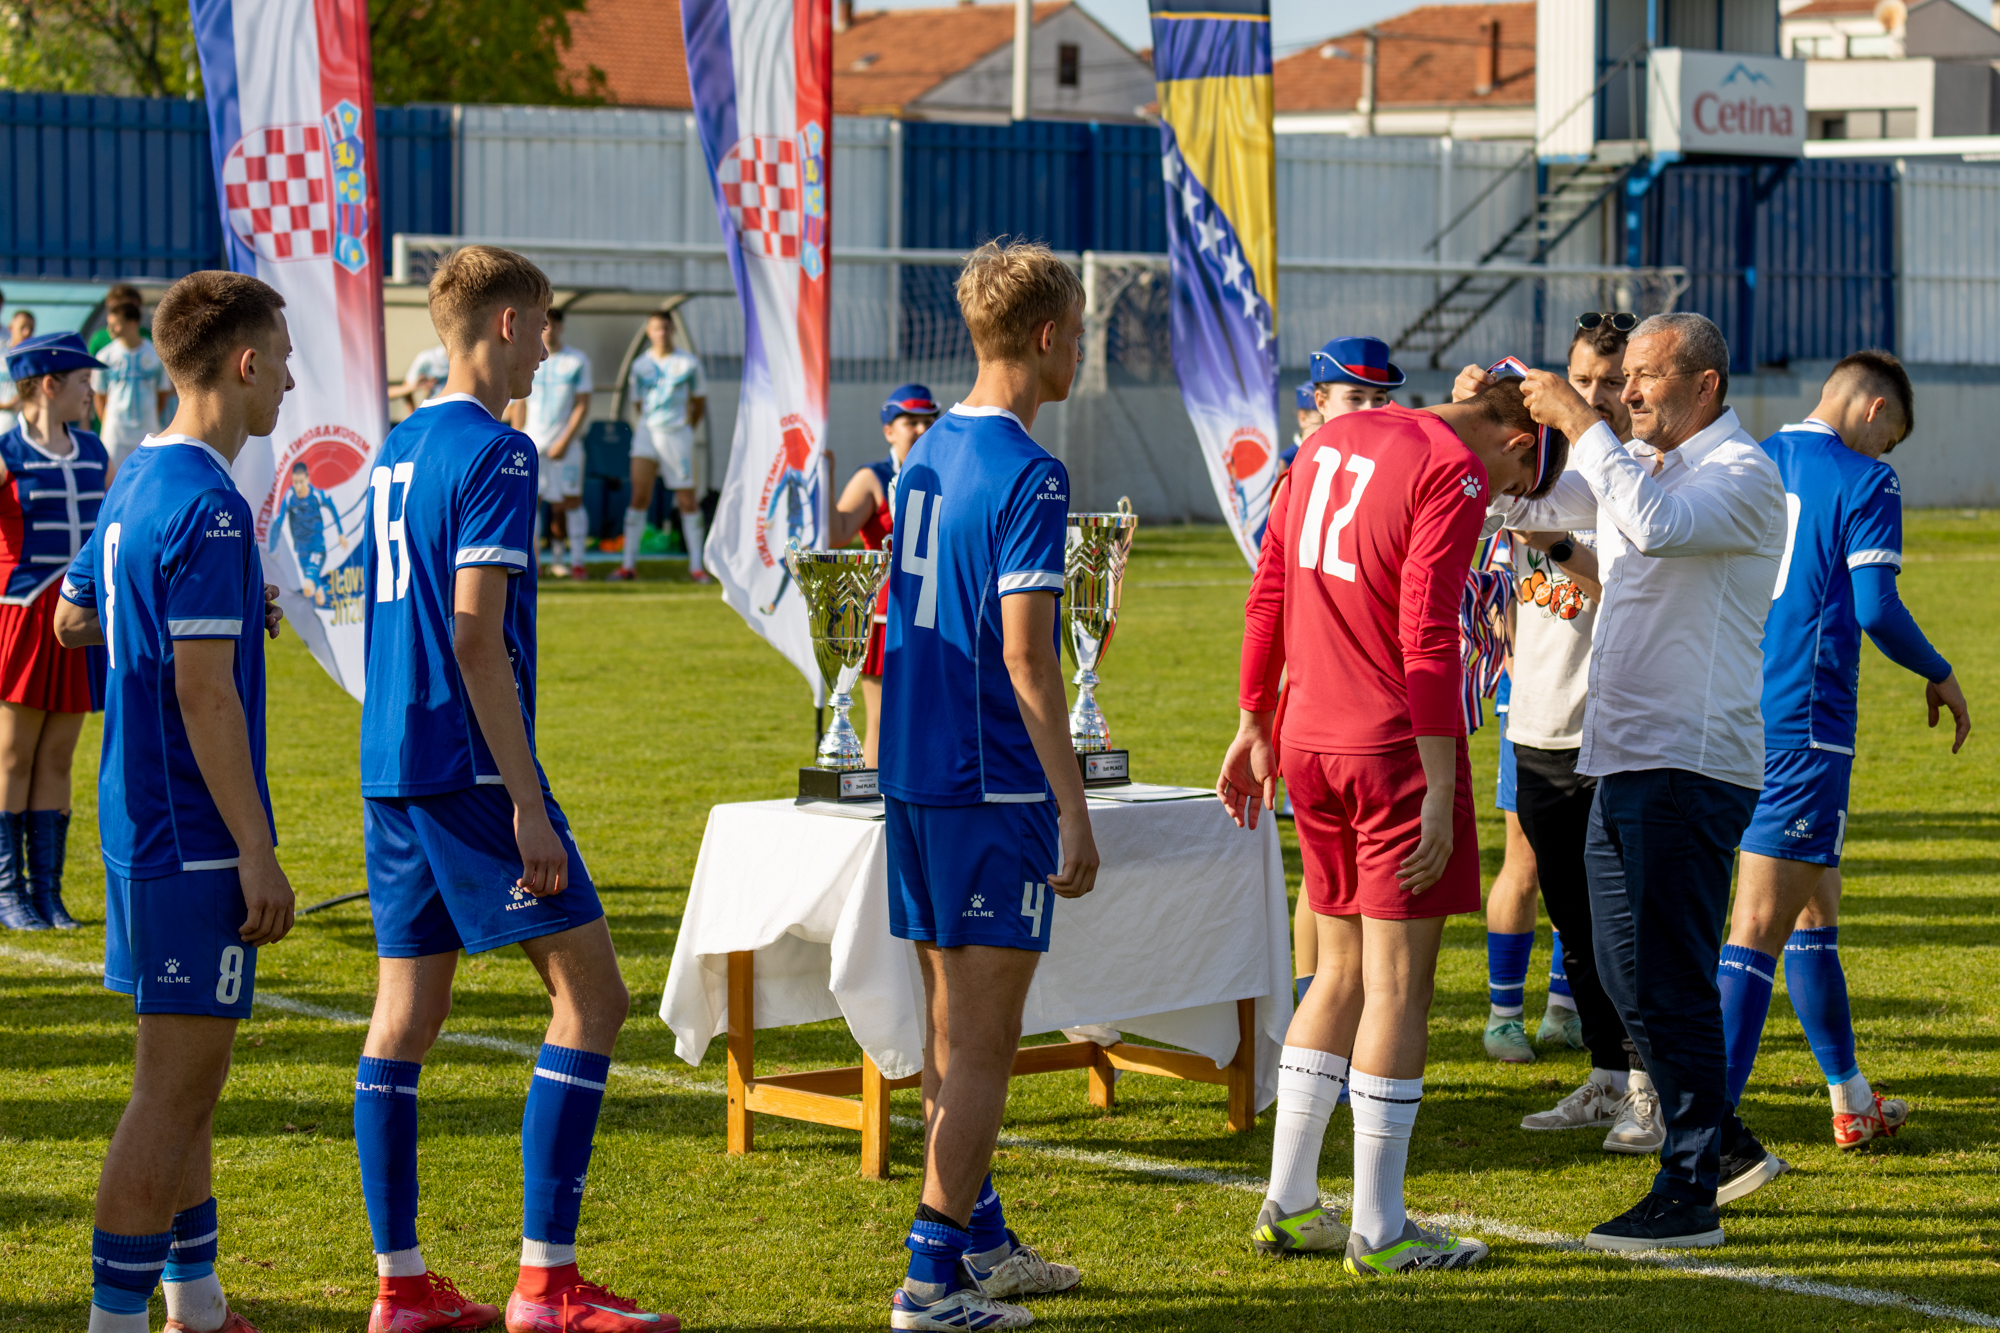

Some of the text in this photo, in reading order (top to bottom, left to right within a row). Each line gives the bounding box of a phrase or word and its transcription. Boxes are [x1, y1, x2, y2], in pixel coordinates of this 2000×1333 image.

[1692, 90, 1794, 137] Cetina
[501, 467, 529, 477] KELM
[1036, 492, 1067, 502] KELME
[1299, 445, 1376, 582] 12
[205, 529, 242, 538] KELME
[901, 489, 943, 629] 4
[1784, 829, 1814, 839] KELME
[504, 898, 539, 912] KELME
[1020, 881, 1046, 938] 4
[962, 910, 995, 918] KELME
[157, 975, 191, 984] KELME
[215, 945, 244, 1005] 8
[1284, 1064, 1339, 1082] KELME
[355, 1081, 394, 1094] ELME
